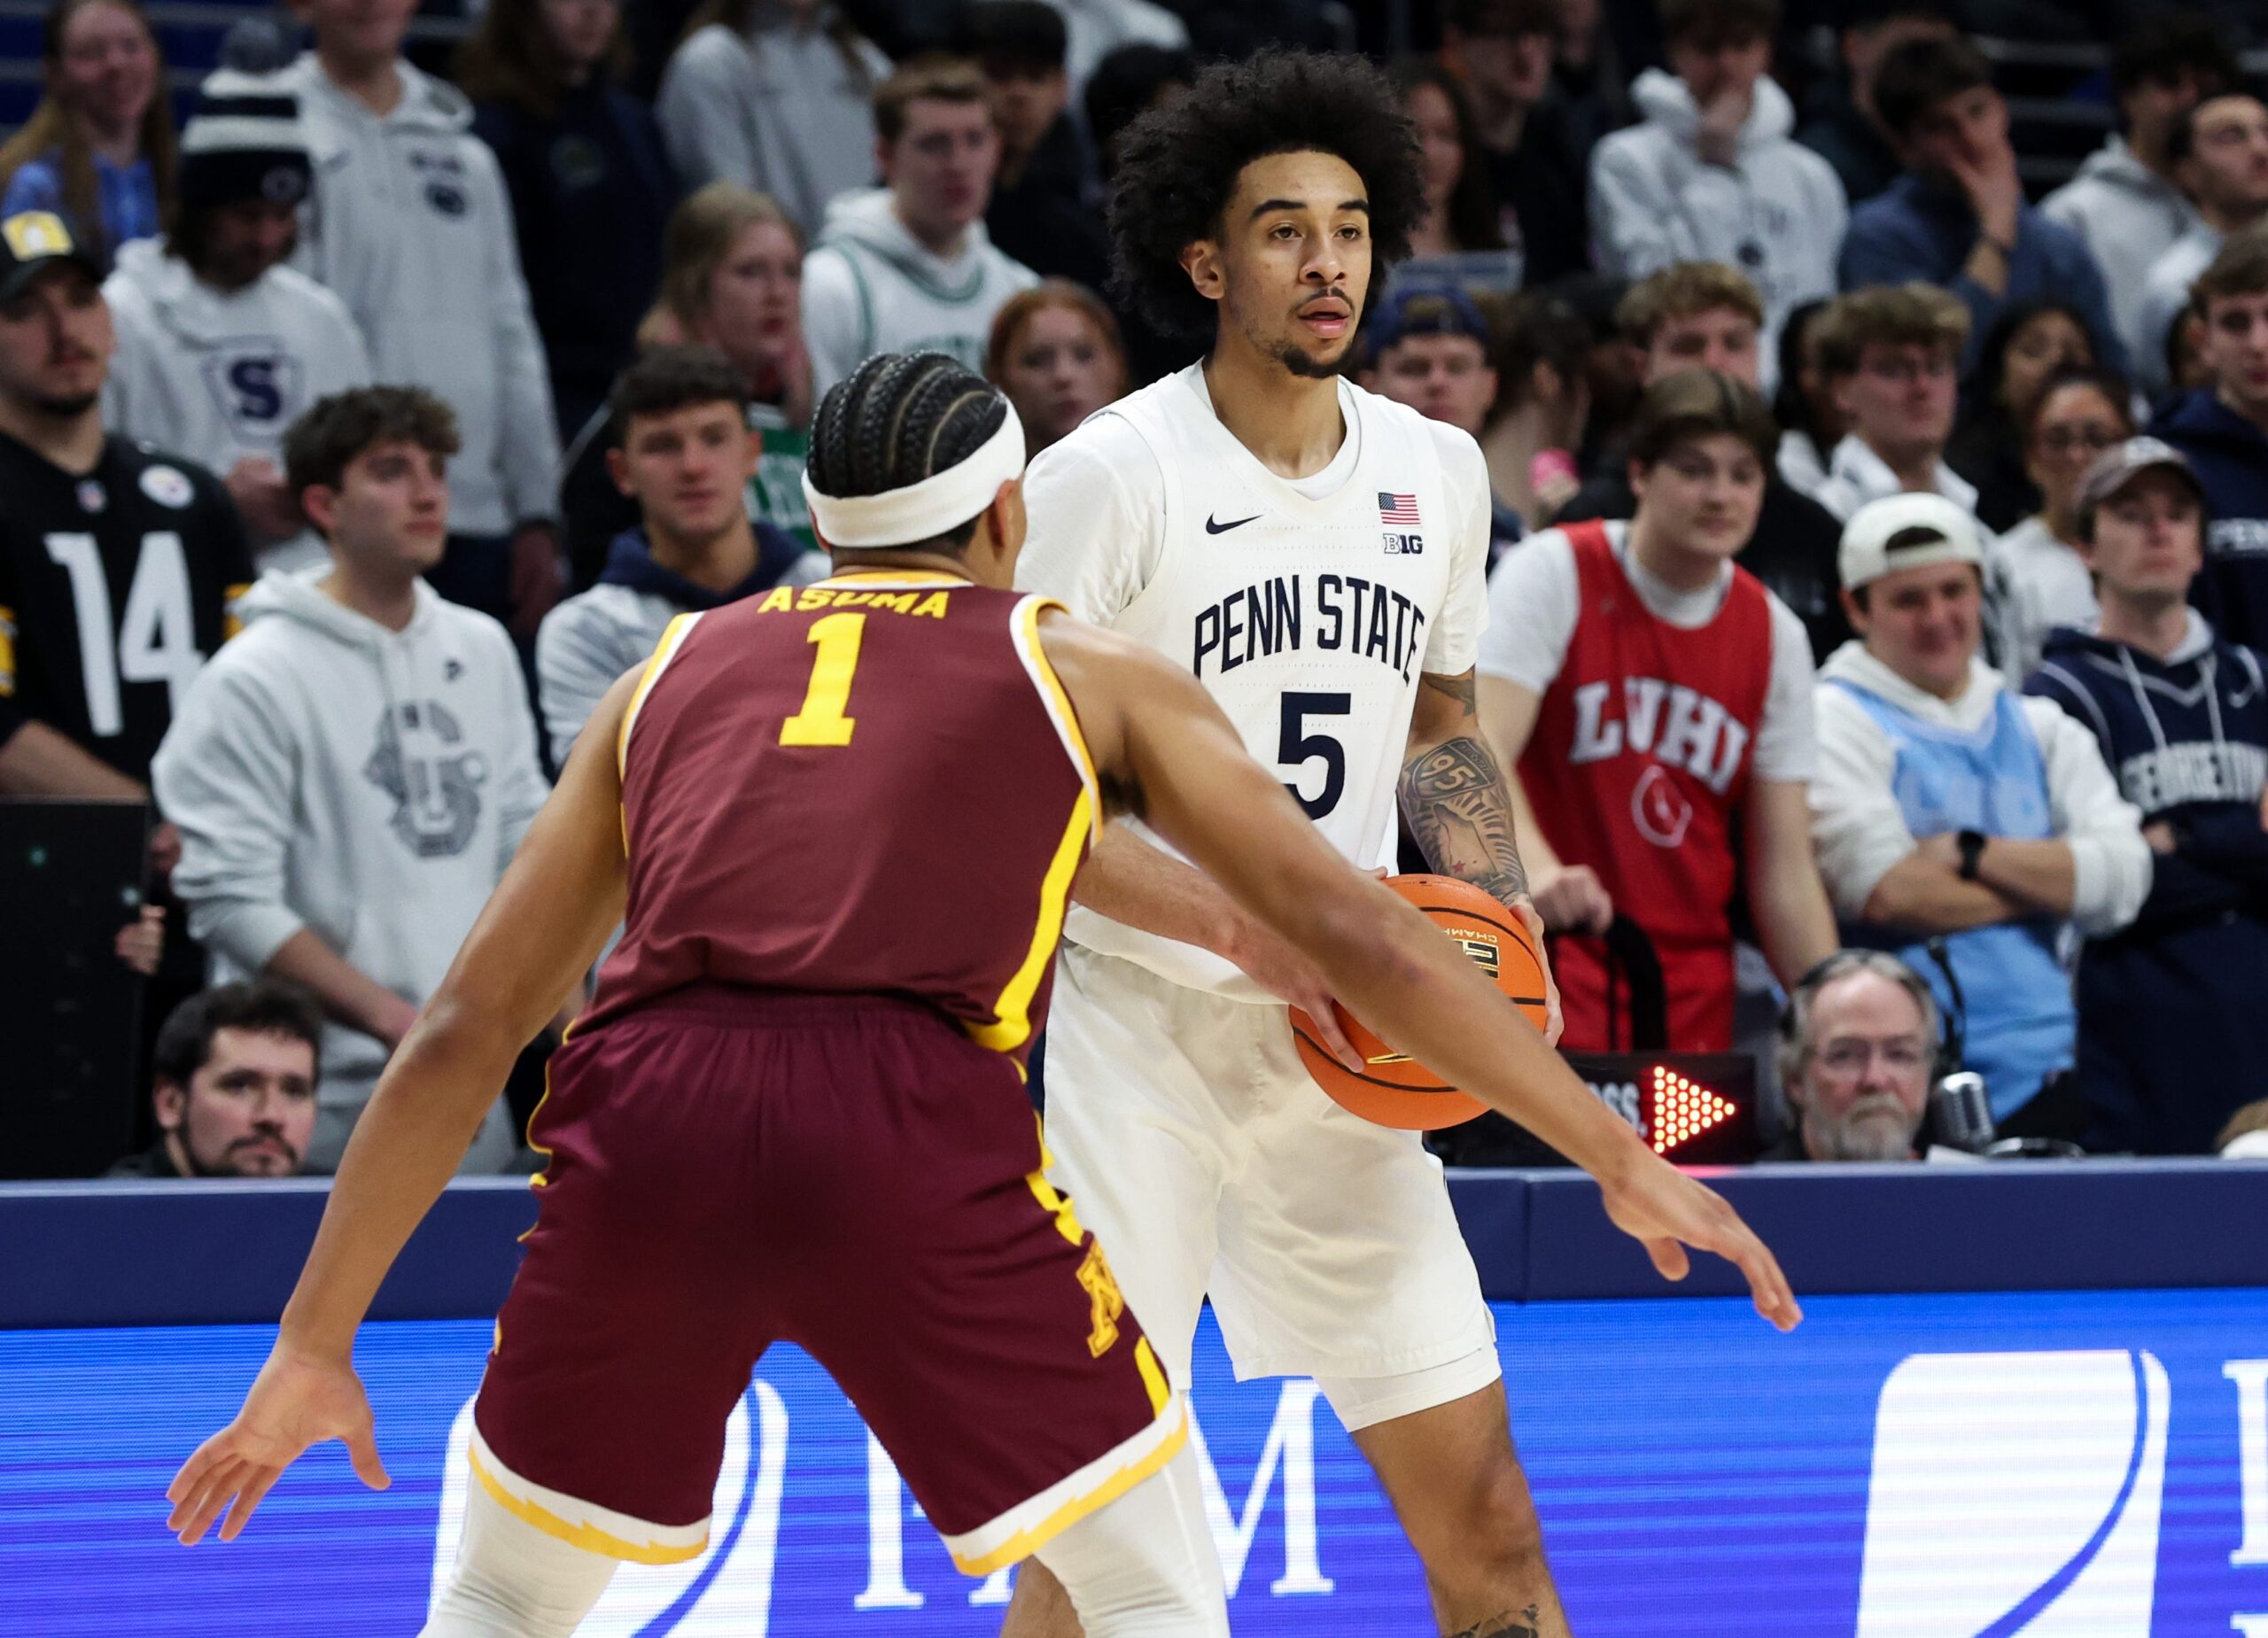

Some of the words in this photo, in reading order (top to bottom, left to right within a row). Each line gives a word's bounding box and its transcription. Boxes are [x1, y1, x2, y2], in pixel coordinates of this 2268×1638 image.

[229, 359, 282, 419] S
[43, 531, 207, 738] 14
[757, 585, 950, 618] ASUMA
[1193, 574, 1301, 680] PENN
[1317, 573, 1425, 687] STATE
[779, 612, 867, 746] 1
[1278, 691, 1352, 821] 5
[1420, 754, 1477, 791] 95
